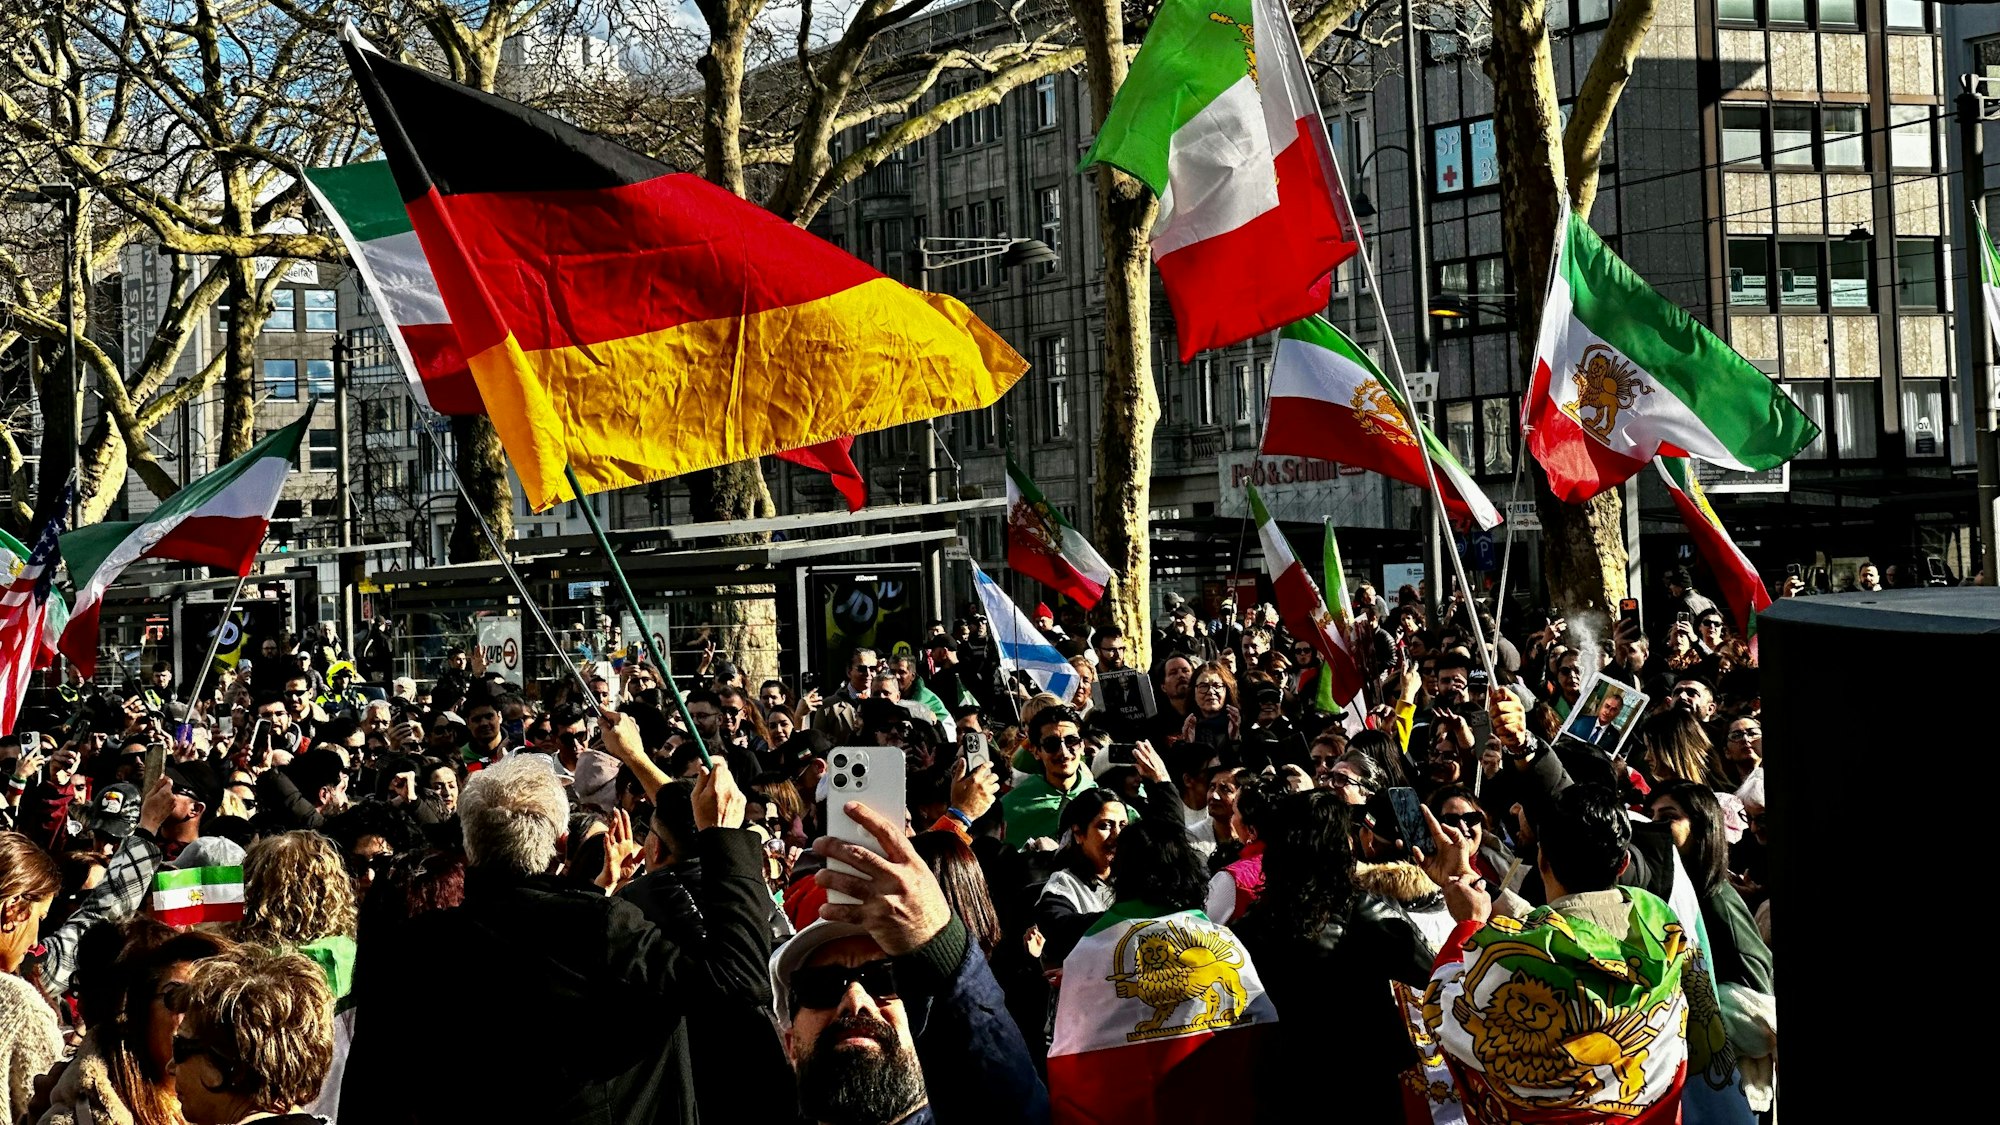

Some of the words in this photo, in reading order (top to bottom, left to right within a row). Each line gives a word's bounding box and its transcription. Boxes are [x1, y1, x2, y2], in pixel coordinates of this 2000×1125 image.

[129, 289, 141, 364] HAUS
[144, 249, 156, 338] ERNEN
[1480, 541, 1489, 558] P
